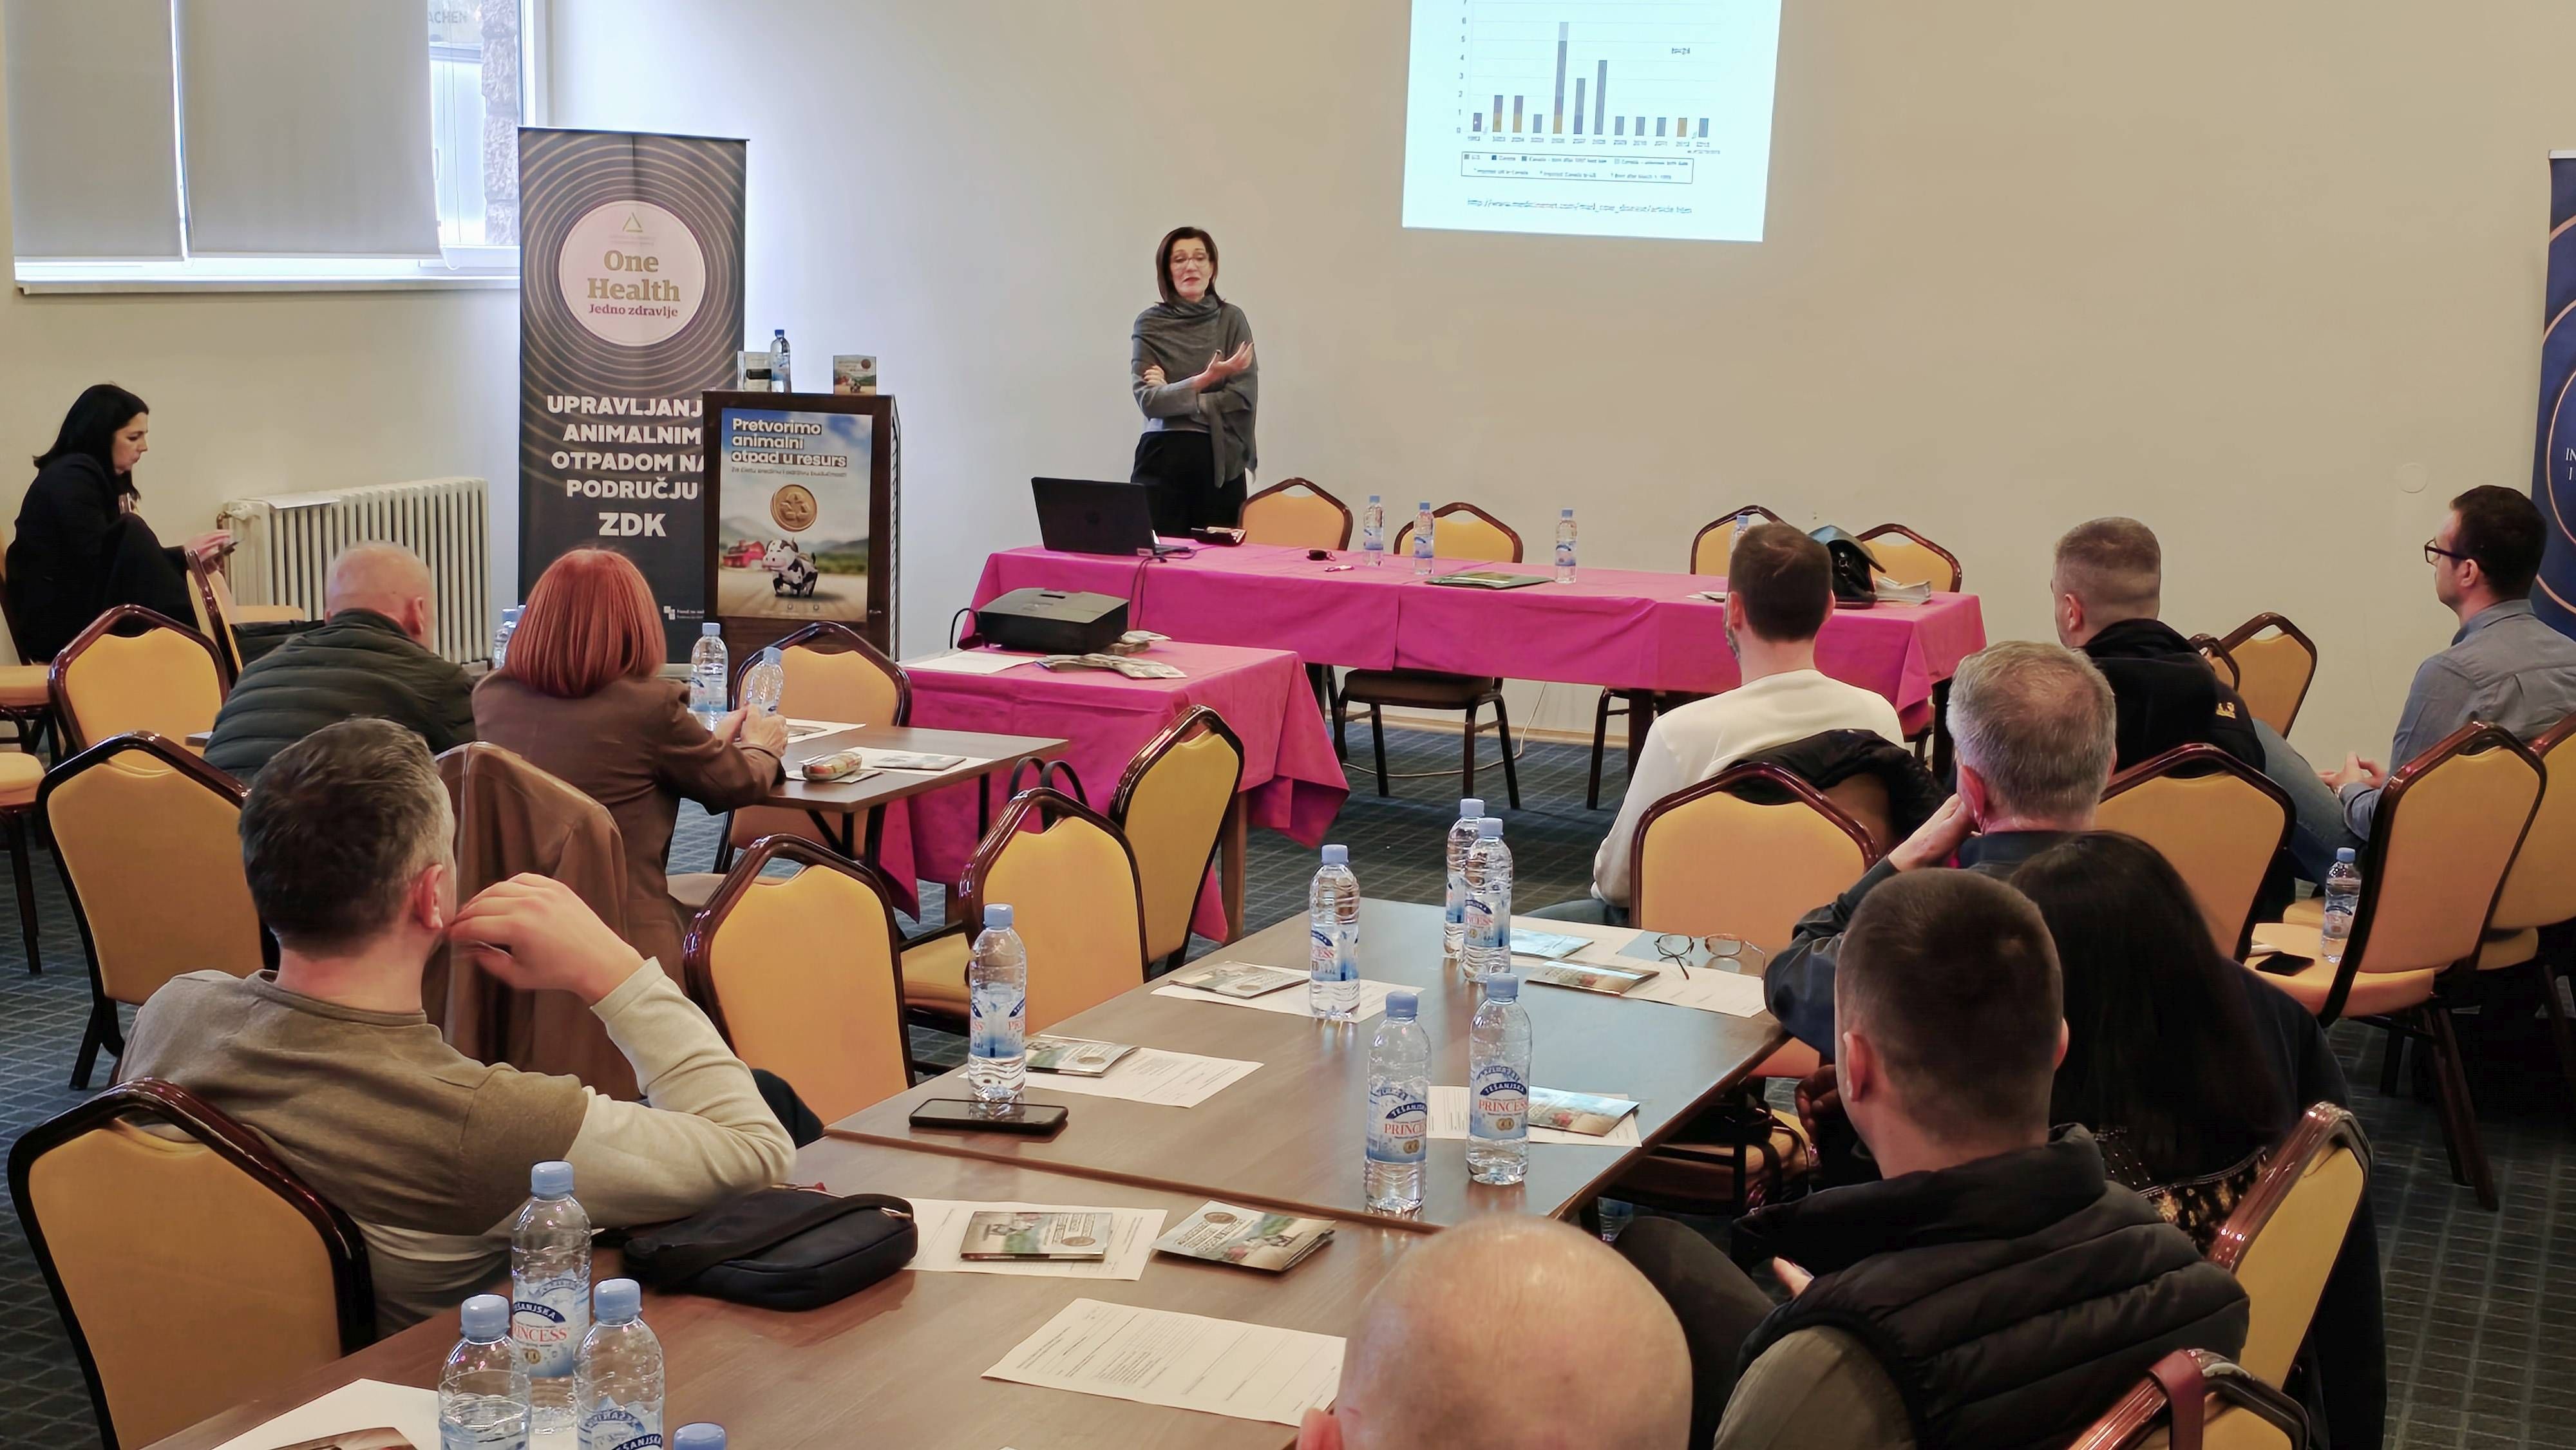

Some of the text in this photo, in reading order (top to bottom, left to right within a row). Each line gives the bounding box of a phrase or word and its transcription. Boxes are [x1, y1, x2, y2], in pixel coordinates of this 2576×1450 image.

[604, 250, 659, 272] One
[587, 278, 680, 301] Health
[589, 304, 678, 319] Jedno zdravlje
[547, 395, 703, 417] UPRAVLJANJ
[563, 424, 701, 445] ANIMALNIM
[732, 418, 822, 435] Pretvorimo
[732, 434, 804, 449] animalni
[551, 451, 674, 472] OTPADOM
[732, 450, 847, 466] otpad u resurs
[567, 476, 698, 500] PODRUČJU
[599, 513, 667, 537] ZDK
[1385, 1123, 1426, 1135] PRINCE
